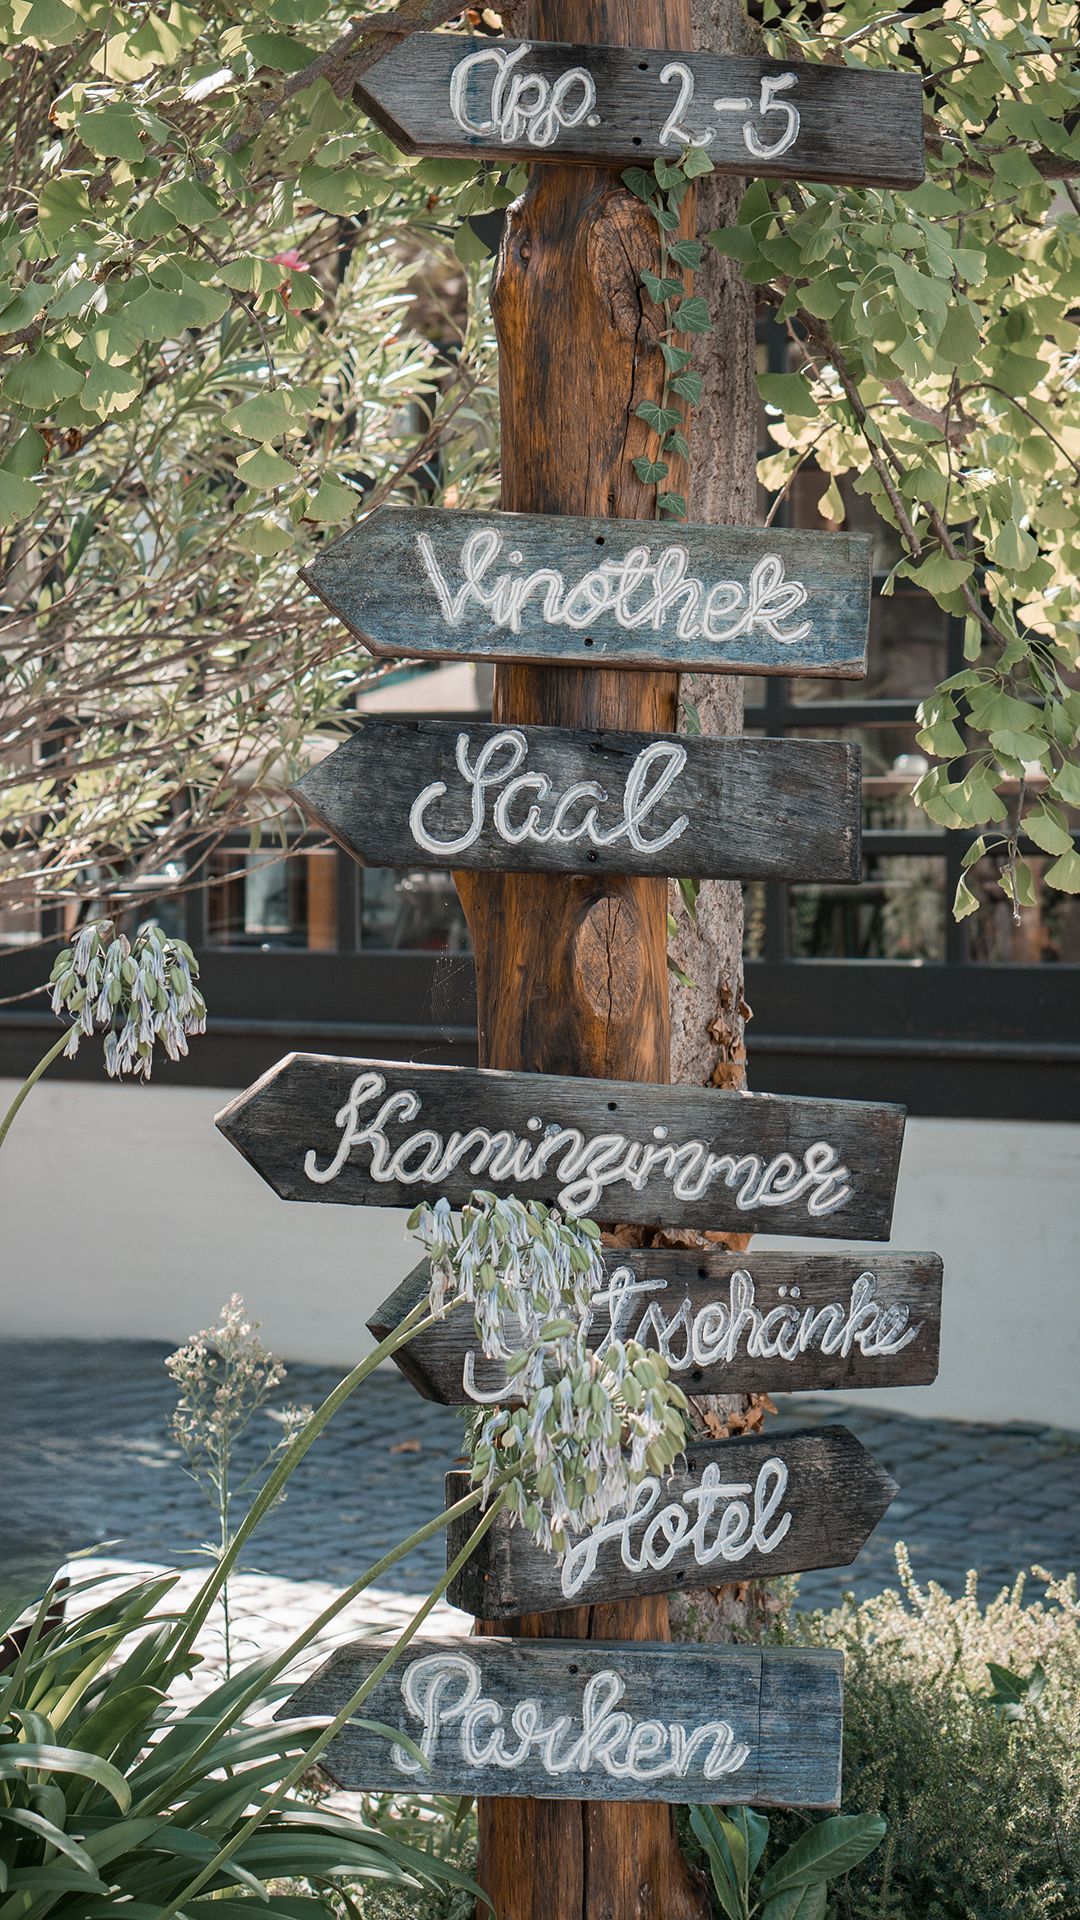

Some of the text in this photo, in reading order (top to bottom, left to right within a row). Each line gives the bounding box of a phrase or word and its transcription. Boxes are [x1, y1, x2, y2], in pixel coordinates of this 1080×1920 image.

[449, 43, 801, 160] App. 2-5
[415, 527, 814, 644] Vinothek
[409, 729, 690, 855] Saal
[304, 1071, 855, 1217] Kaminzimmer
[463, 1265, 921, 1403] tsschänke
[561, 1456, 792, 1598] Hotel
[390, 1651, 751, 1781] Parken
